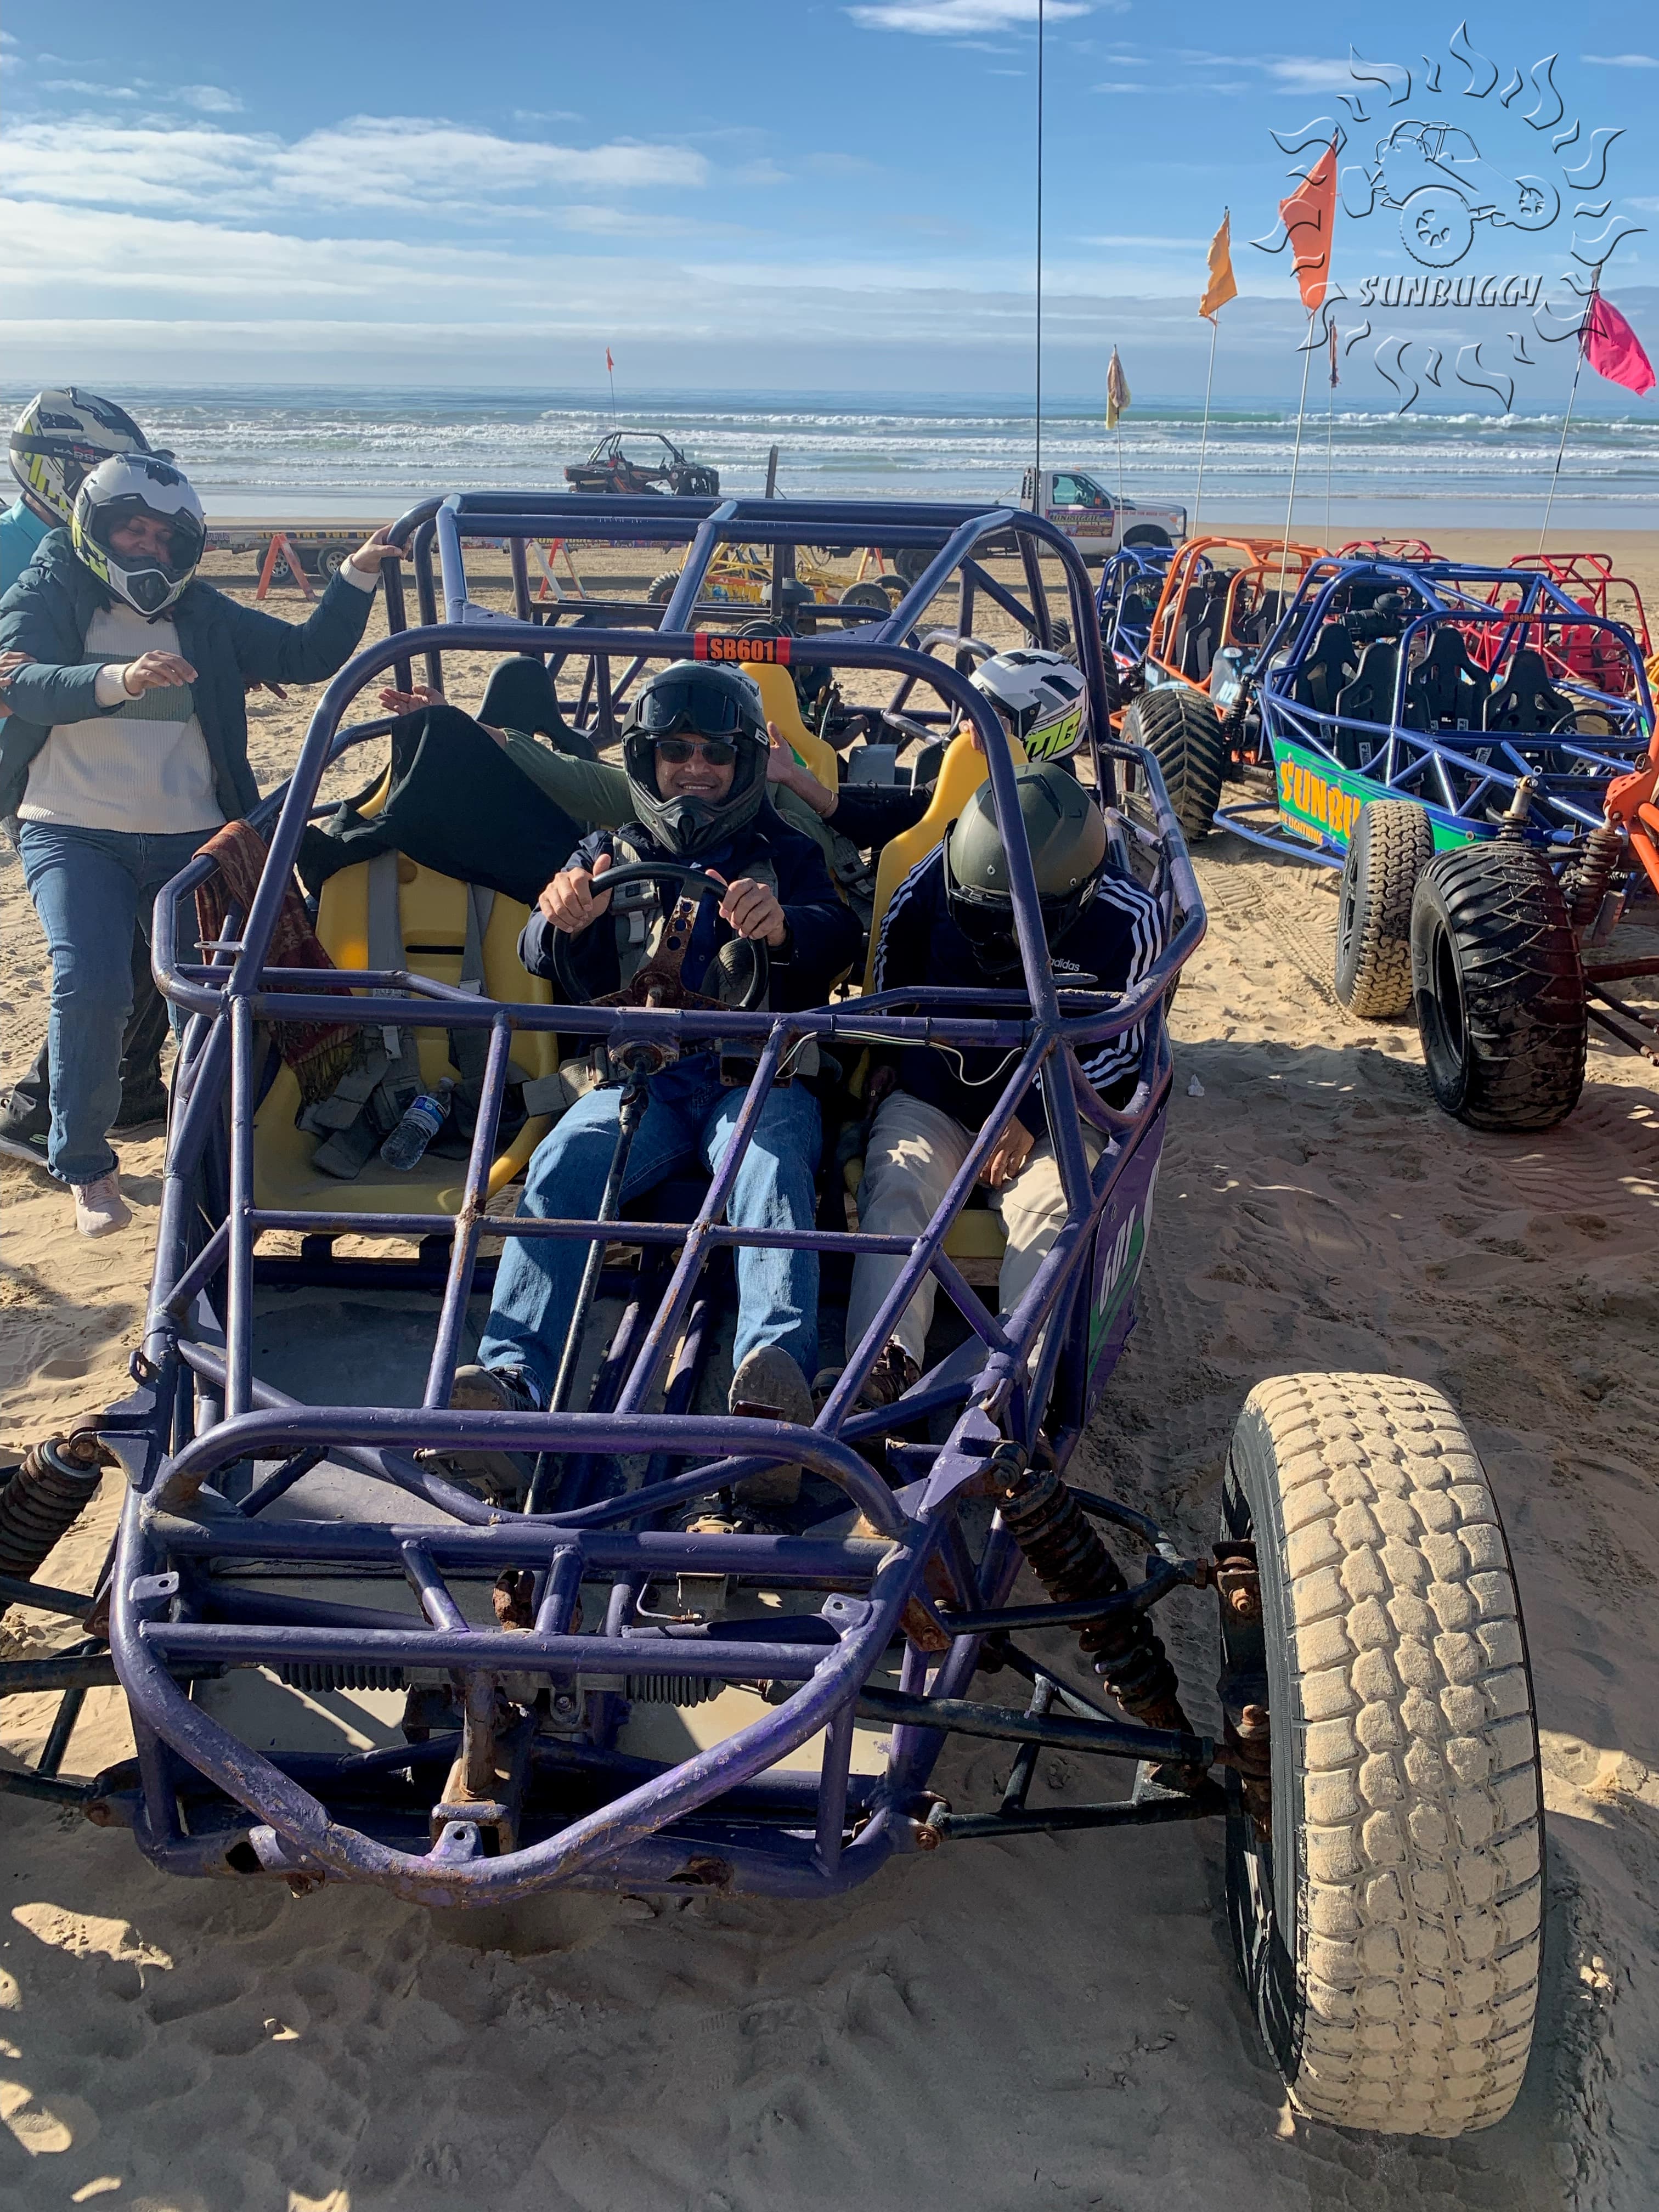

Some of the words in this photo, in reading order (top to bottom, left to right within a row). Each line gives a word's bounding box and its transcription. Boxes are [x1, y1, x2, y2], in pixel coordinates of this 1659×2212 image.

[710, 638, 774, 662] SB601
[1280, 760, 1361, 839] SUNBU
[1051, 958, 1080, 972] adidas
